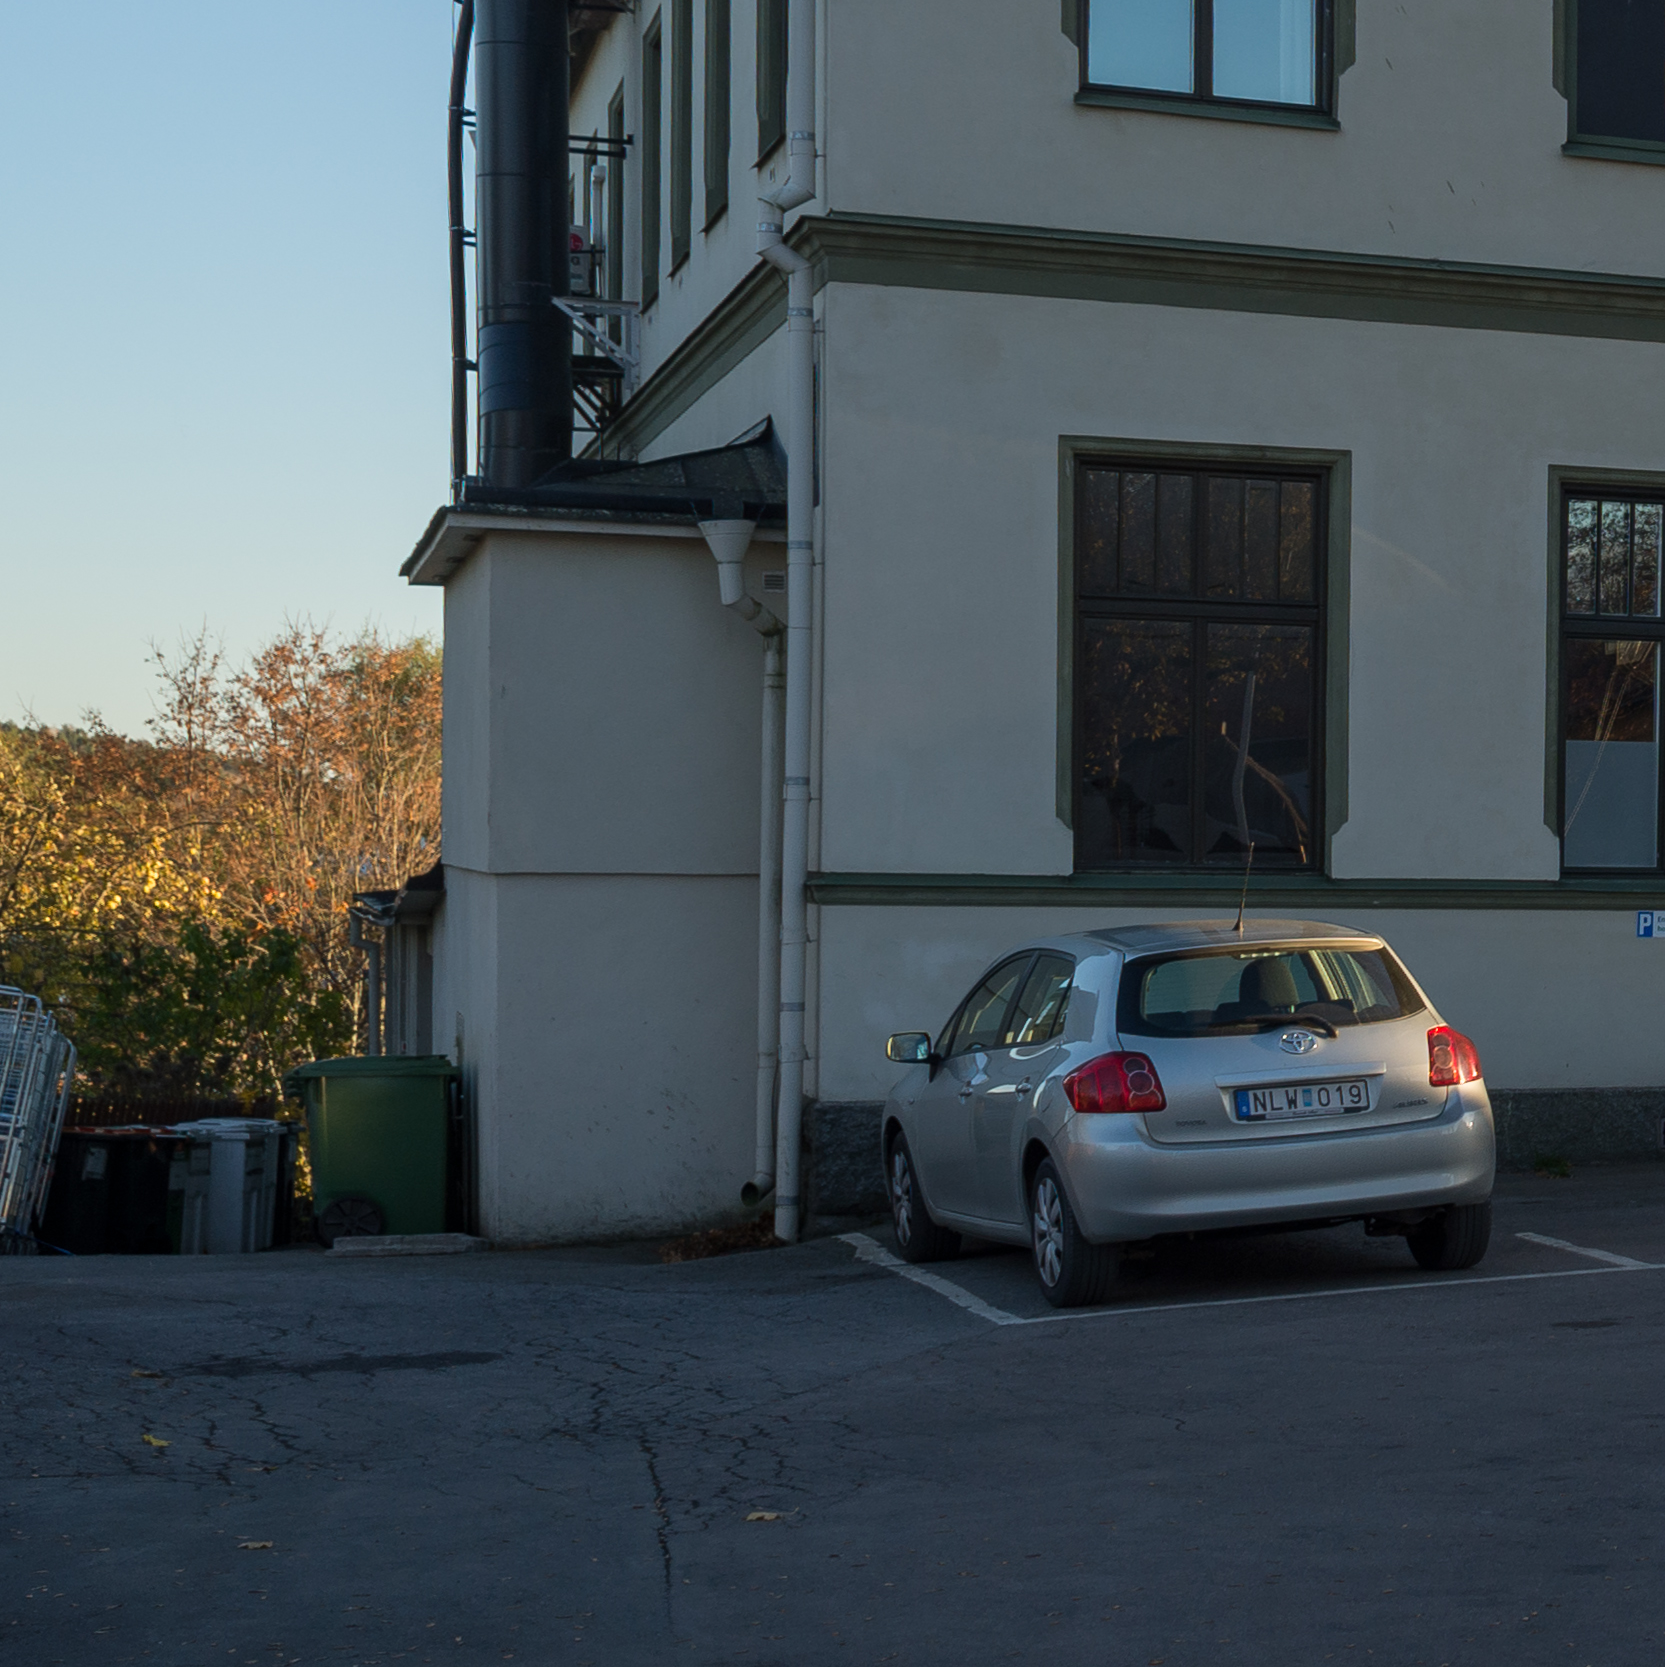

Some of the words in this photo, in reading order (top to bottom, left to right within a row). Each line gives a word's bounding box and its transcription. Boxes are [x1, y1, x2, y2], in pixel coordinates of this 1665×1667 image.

[1639, 914, 1651, 935] P
[1252, 1088, 1298, 1113] NLW
[1317, 1084, 1363, 1107] 019
